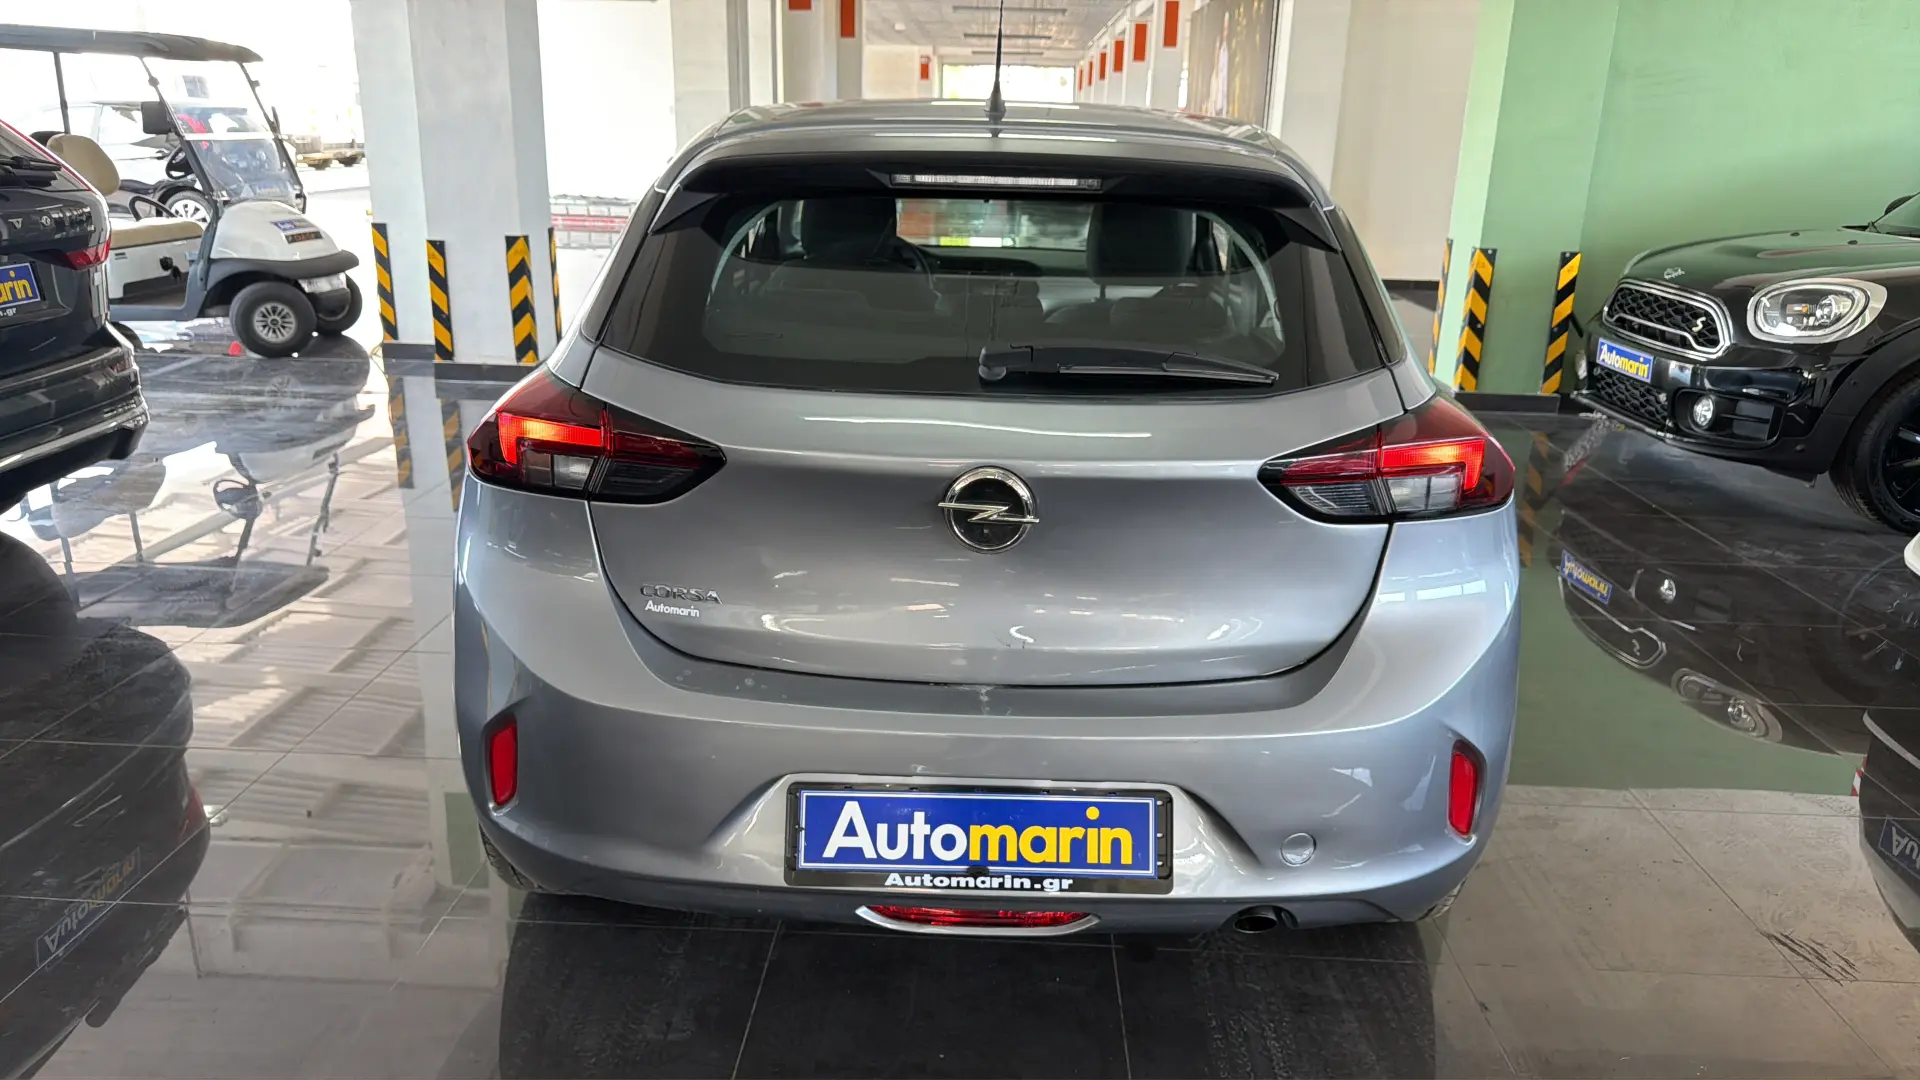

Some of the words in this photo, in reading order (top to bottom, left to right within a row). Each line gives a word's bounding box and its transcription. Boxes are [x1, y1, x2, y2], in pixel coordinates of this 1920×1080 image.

[1600, 343, 1650, 378] Automarin
[640, 583, 723, 605] CORSA
[644, 600, 700, 617] Automarin
[821, 800, 1134, 865] Automarin
[884, 872, 1074, 892] Automarin.gr
